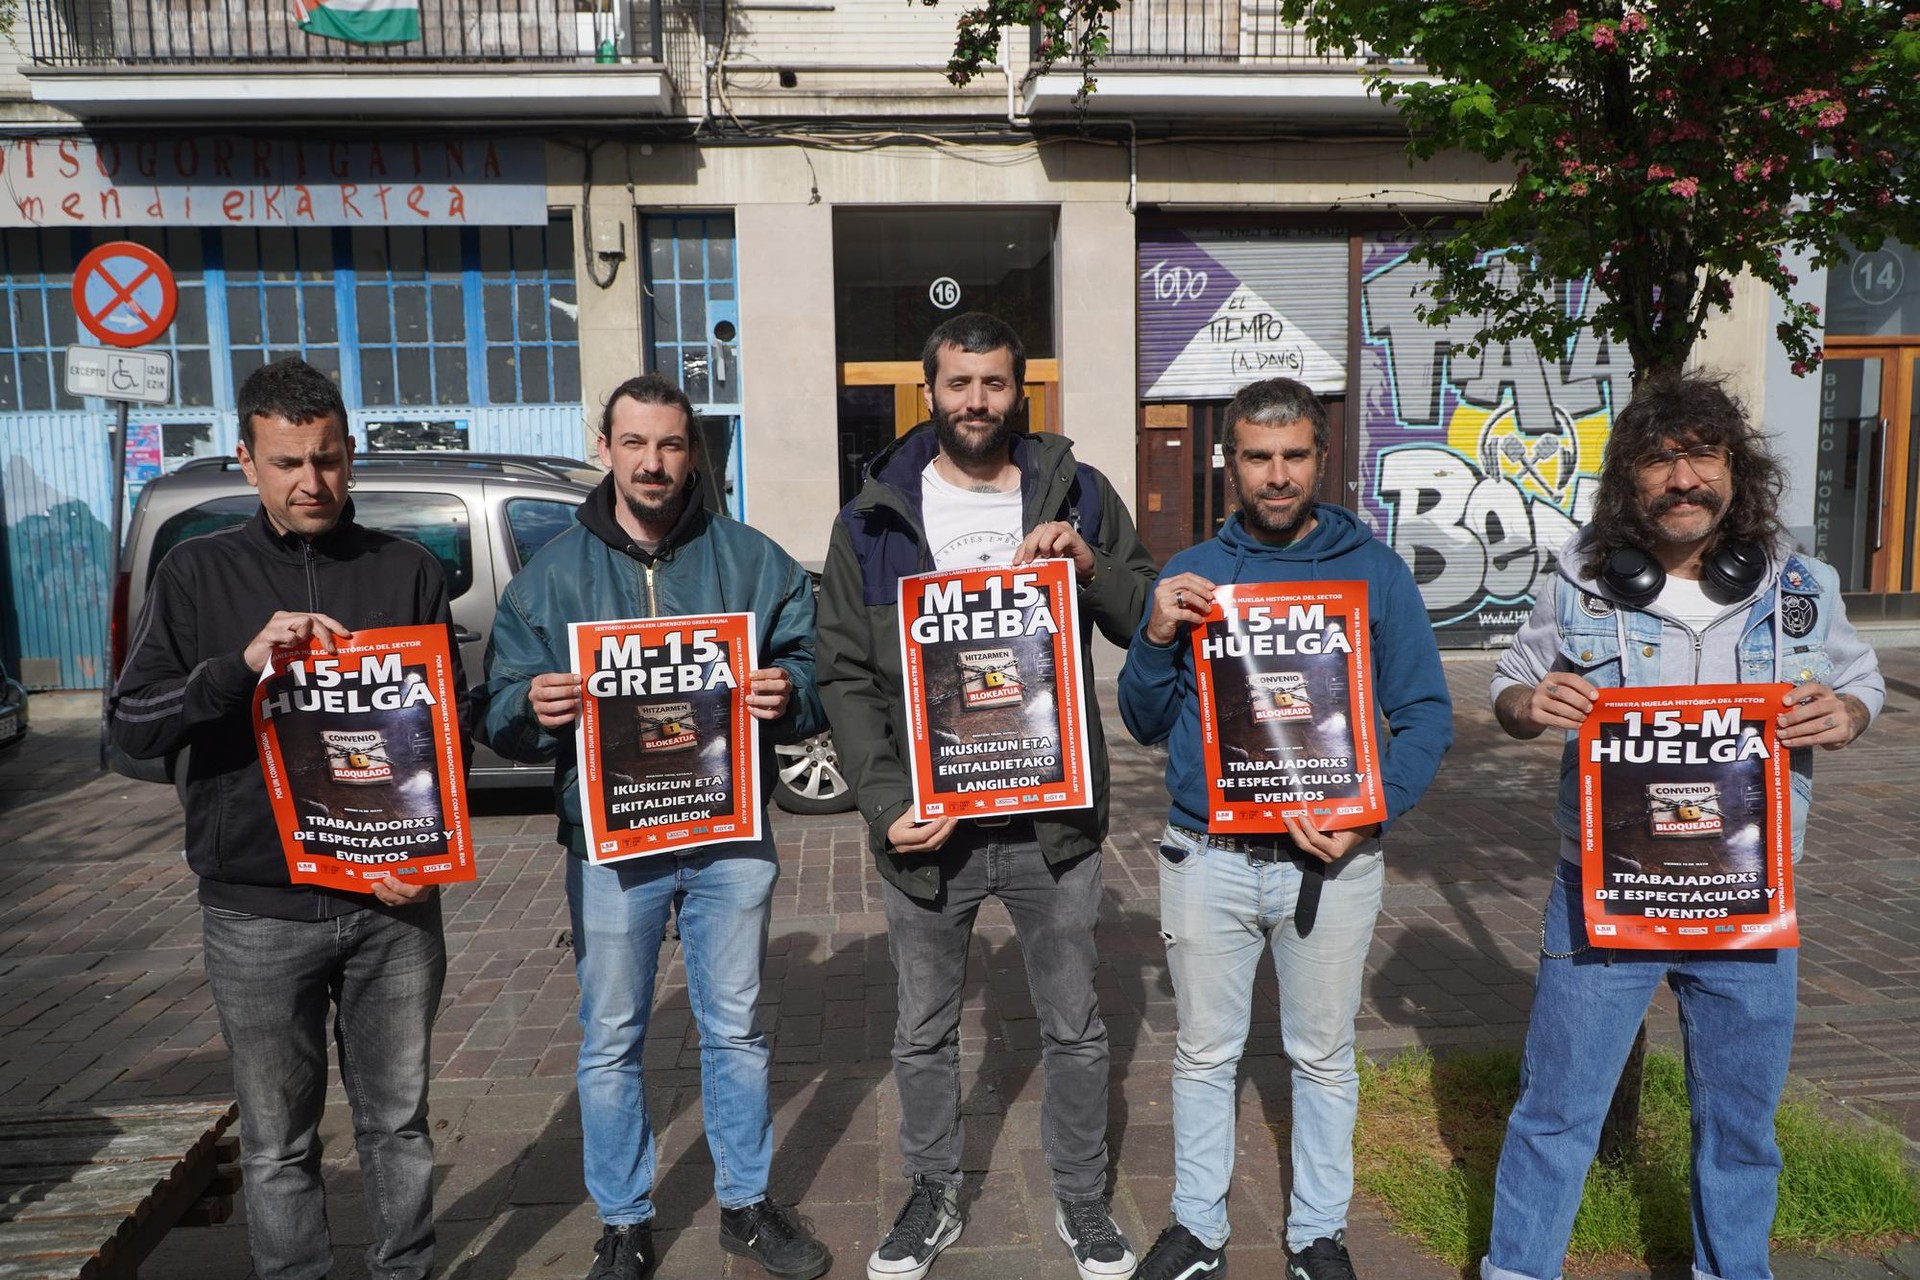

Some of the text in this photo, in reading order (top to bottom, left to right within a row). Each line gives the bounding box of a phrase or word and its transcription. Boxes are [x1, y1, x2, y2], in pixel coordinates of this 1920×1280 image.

[0, 138, 501, 178] TSOGORRIGAINA
[19, 186, 191, 220] mendi
[1141, 260, 1208, 306] TODO
[1859, 262, 1895, 290] 14
[935, 283, 956, 302] 16
[1228, 296, 1245, 309] EL
[1202, 313, 1283, 343] TIEMPO
[70, 367, 106, 377] EXCEPTO
[147, 366, 166, 376] IZAN
[147, 381, 166, 390] EZIK
[1821, 373, 1837, 452] BUENO
[924, 573, 1039, 615] M-15
[911, 606, 1058, 644] GREBA
[1222, 604, 1324, 633] 15-M
[1355, 621, 1361, 629] EL
[303, 648, 329, 657] HUELG
[392, 641, 421, 649] SECTOR
[601, 629, 719, 670] M-15
[1202, 631, 1353, 660] HUELGA
[909, 648, 917, 664] ALDE
[965, 651, 1009, 661] HITZARMEN
[286, 653, 403, 688] 15-M
[437, 669, 443, 677] EL
[1357, 671, 1363, 679] DE
[587, 662, 737, 698] GREBA
[261, 682, 437, 721] HUELGA
[970, 687, 1019, 702] BLOKEATUA
[1675, 698, 1717, 706] HISTÓRICA
[643, 704, 687, 714] HITZARMEN
[1256, 707, 1311, 719] BLOQUEADO
[443, 723, 450, 732] DE
[1205, 722, 1211, 731] UN
[1623, 707, 1742, 738] 15-M
[328, 733, 376, 743] CONVENIO
[444, 733, 452, 745] LAS
[645, 734, 695, 749] BLOKEATUA
[940, 736, 1050, 756] IKUSKIZUN ETA
[1590, 736, 1770, 765] HUELGA
[939, 756, 1055, 775] EKITALDIETAKO
[1228, 758, 1348, 771] TRABAJADORXS
[1365, 754, 1371, 762] LA
[334, 767, 391, 778] BLOQUEADO
[613, 776, 722, 796] IKUSKIZUN ETA
[957, 775, 1041, 793] LANGILEOK
[1217, 773, 1365, 788] DE ESPECTÁCULOS Y
[1775, 777, 1781, 786] DE
[1254, 790, 1324, 803] EVENTOS
[1655, 785, 1711, 795] CONVENIO
[612, 792, 726, 814] EKITALDIETAKO
[453, 812, 460, 820] LA
[629, 810, 711, 829] LANGILEOK
[1585, 796, 1593, 828] CONVENIO
[306, 815, 435, 832] TRABAJADORXS
[1655, 820, 1721, 832] BLOQUEADO
[294, 830, 454, 848] DE ESPECTÁCULOS Y
[1586, 828, 1593, 838] UN
[336, 850, 409, 864] EVENTOS
[424, 864, 443, 872] UGT
[1777, 868, 1783, 877] LA
[1612, 872, 1757, 886] TRABAJADORXS
[1595, 888, 1777, 903] DE ESPECTÁCULOS Y
[1644, 907, 1728, 919] EVENTOS
